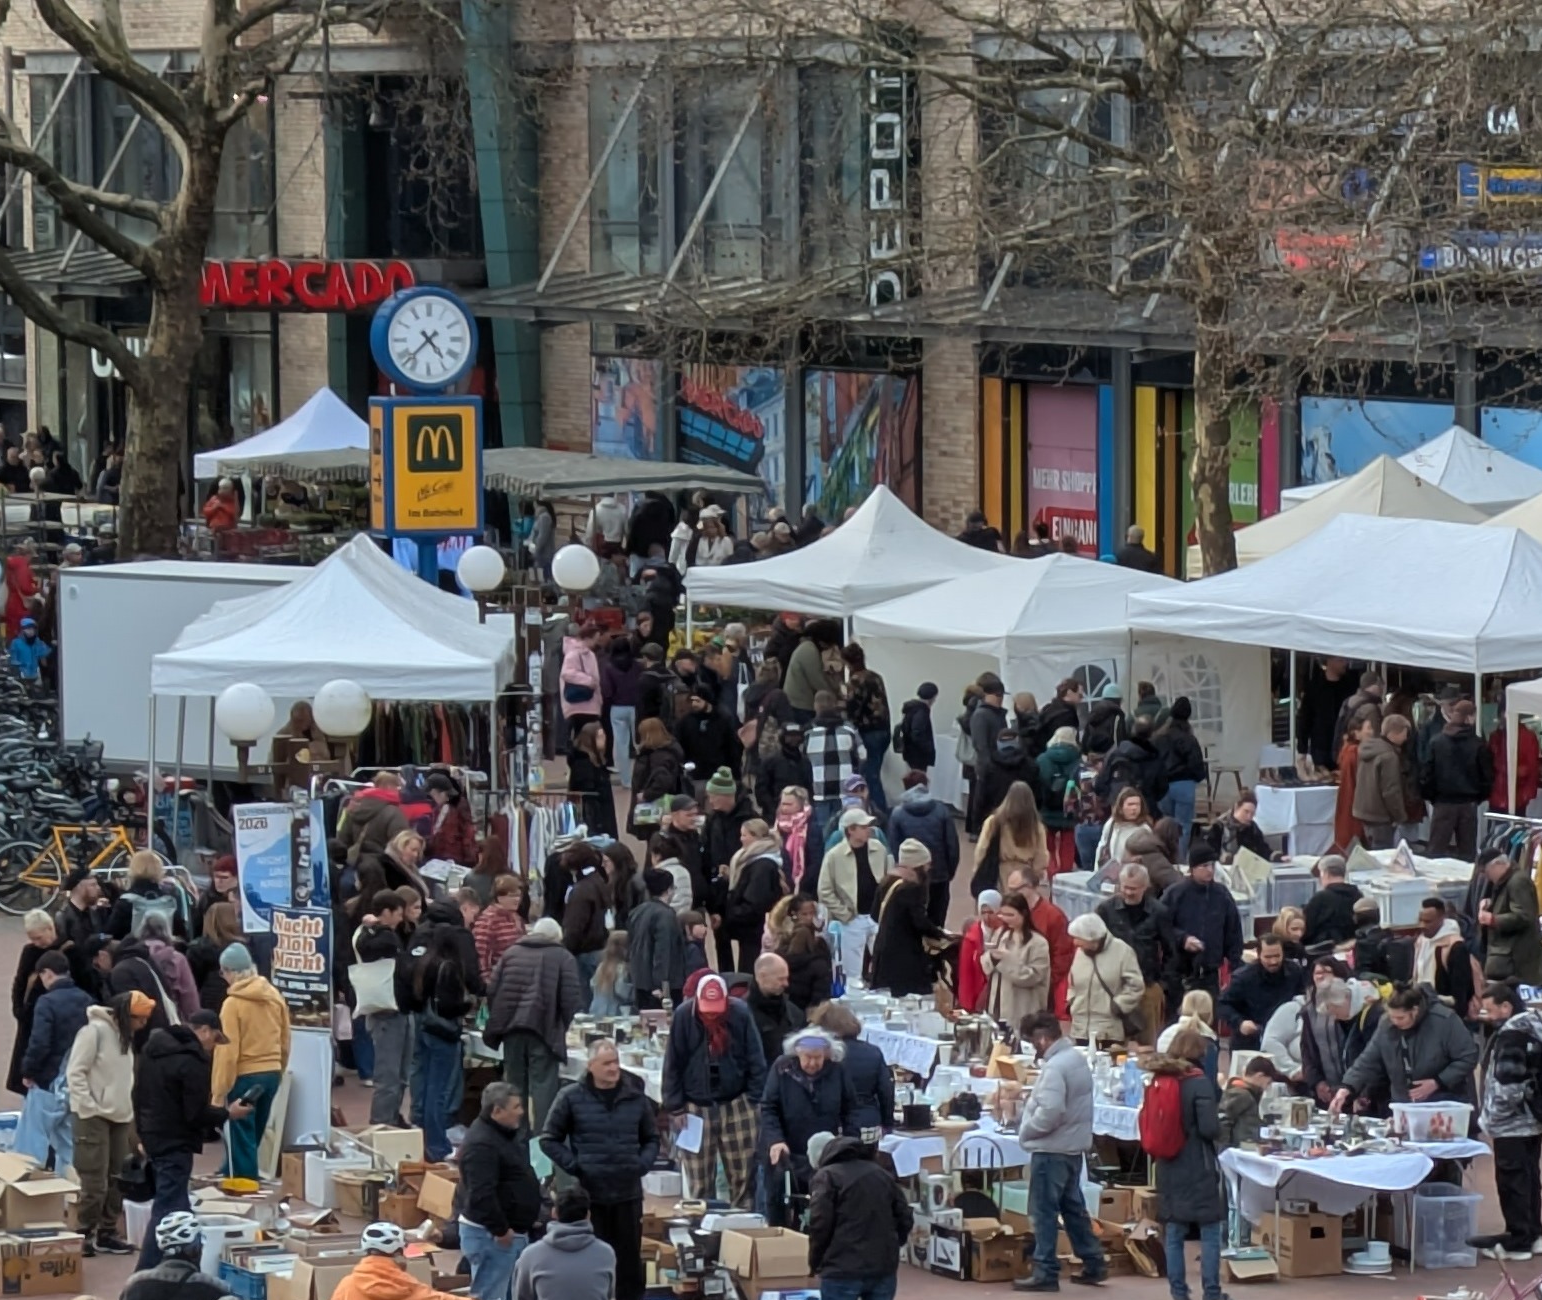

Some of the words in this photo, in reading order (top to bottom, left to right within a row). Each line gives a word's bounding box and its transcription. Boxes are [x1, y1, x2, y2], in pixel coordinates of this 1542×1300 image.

[870, 68, 901, 308] DEPOT
[199, 259, 416, 311] MERCADO
[274, 912, 323, 936] Nacht
[278, 933, 315, 954] Floh
[273, 952, 324, 972] Markt
